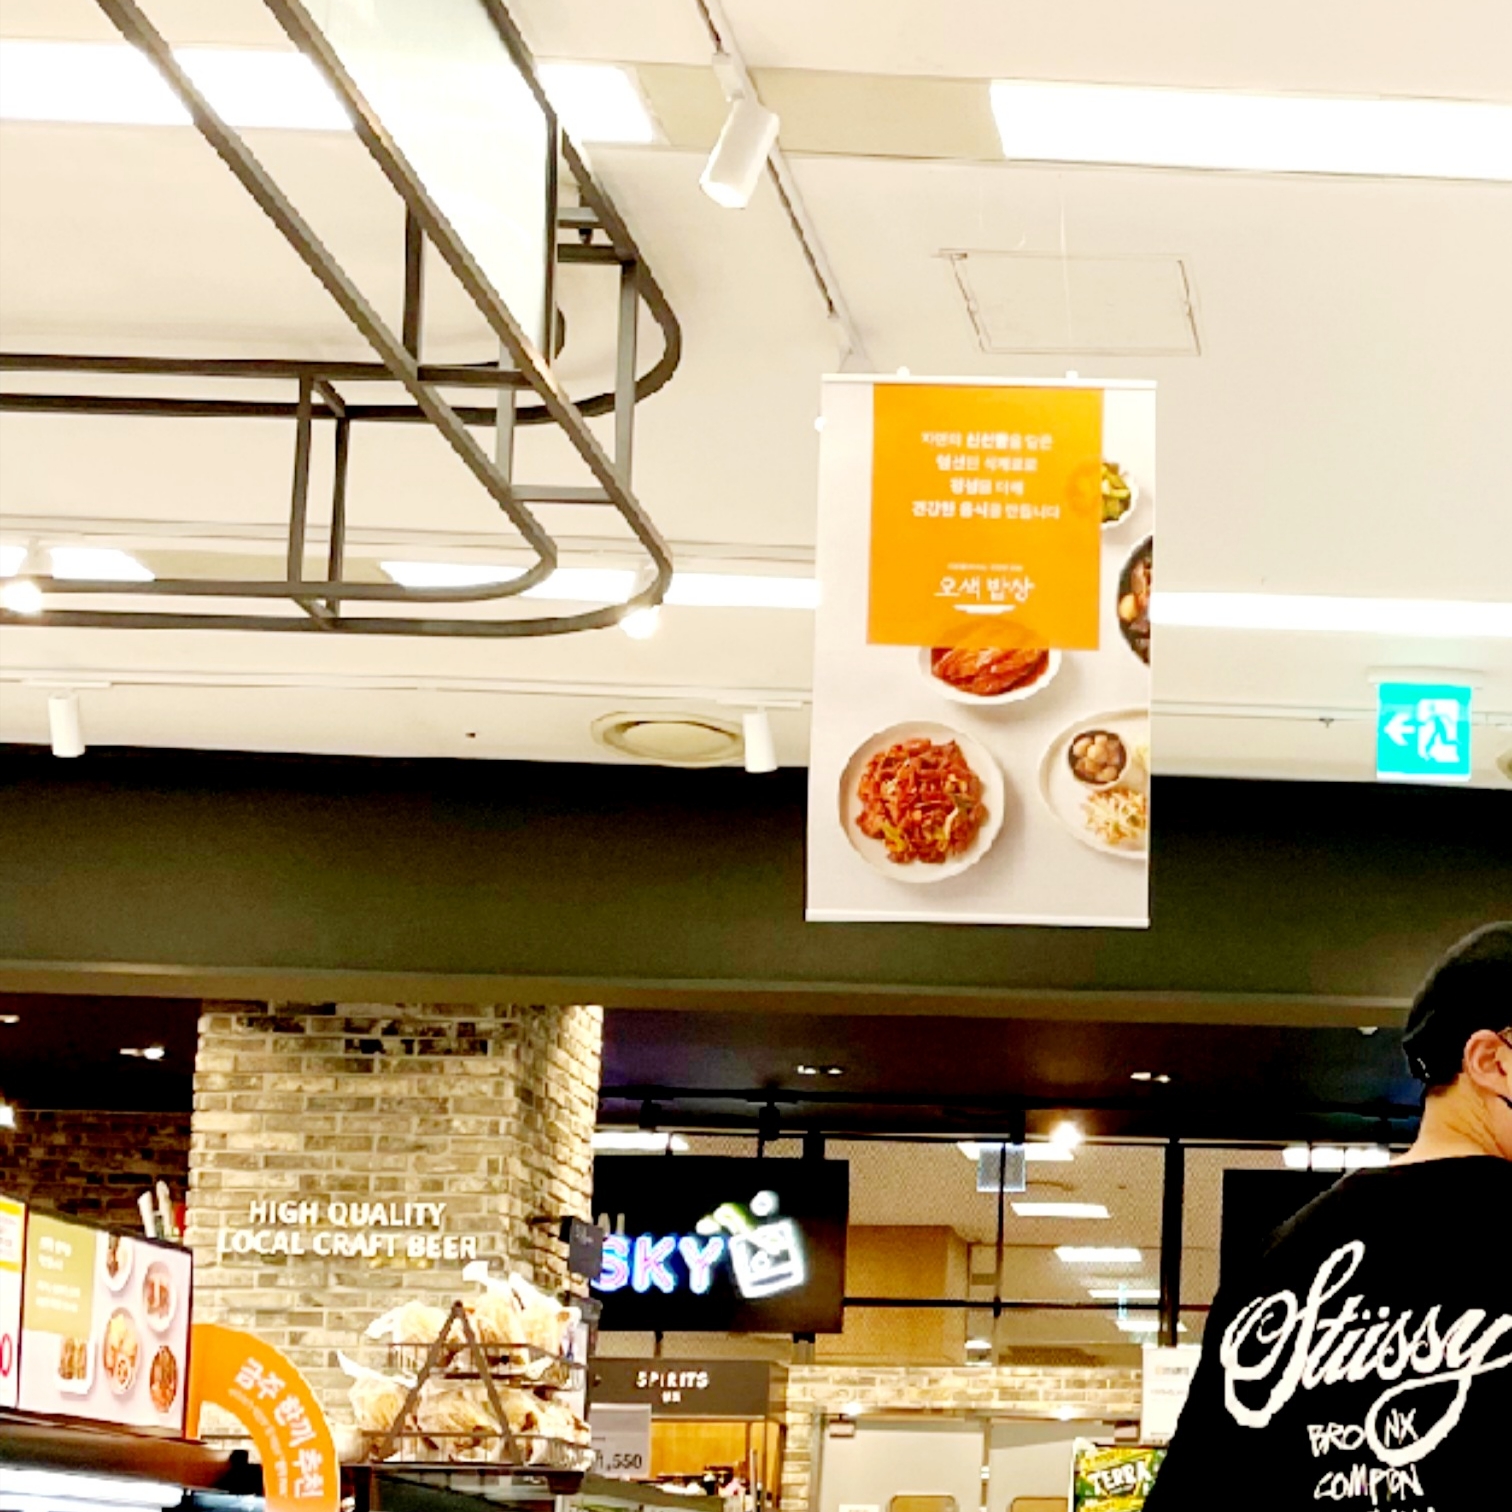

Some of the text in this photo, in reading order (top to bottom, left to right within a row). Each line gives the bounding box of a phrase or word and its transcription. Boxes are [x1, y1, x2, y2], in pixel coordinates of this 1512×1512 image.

[933, 575, 1036, 604] 오색 밥상
[249, 1200, 446, 1227] HIGH QUALITY
[216, 1228, 478, 1260] LOCAL CRAFT BEER
[635, 1371, 709, 1389] SPIRITS
[292, 1449, 324, 1498] 추천
[1087, 1459, 1152, 1495] TERRA
